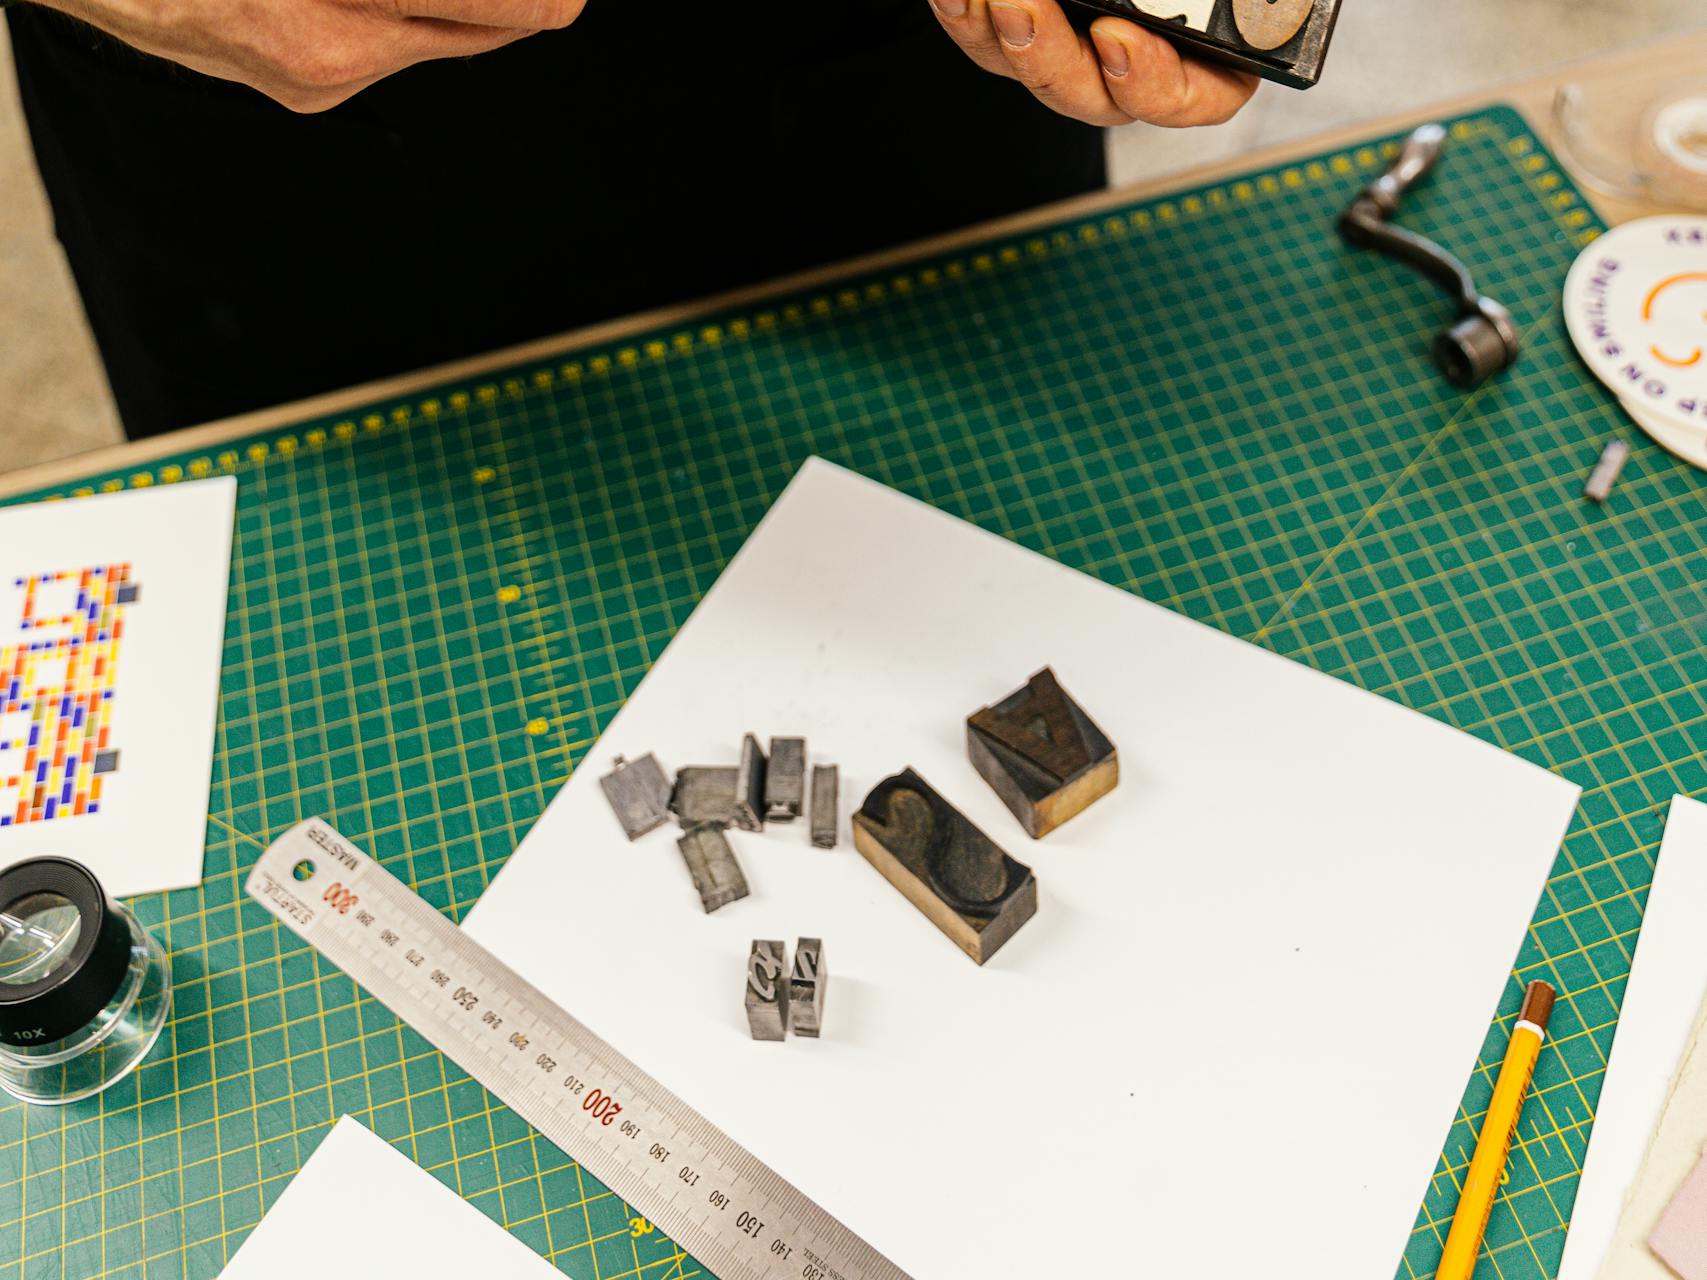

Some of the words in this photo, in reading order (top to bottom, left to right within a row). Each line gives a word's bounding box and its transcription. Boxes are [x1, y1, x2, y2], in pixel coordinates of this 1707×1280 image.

[306, 827, 359, 871] MASTER
[13, 1028, 46, 1040] 10X
[323, 882, 359, 914] 300
[452, 986, 478, 1011] 250
[481, 1010, 503, 1030] 240
[536, 1053, 557, 1073] 220
[563, 1075, 585, 1095] 210
[582, 1088, 623, 1126] 200
[620, 1120, 641, 1140] 190
[648, 1143, 671, 1163] 180
[678, 1166, 700, 1187] 170
[708, 1190, 730, 1211] 160
[735, 1211, 765, 1238] 150
[770, 1238, 793, 1261] 140
[803, 1247, 830, 1273] STEEL
